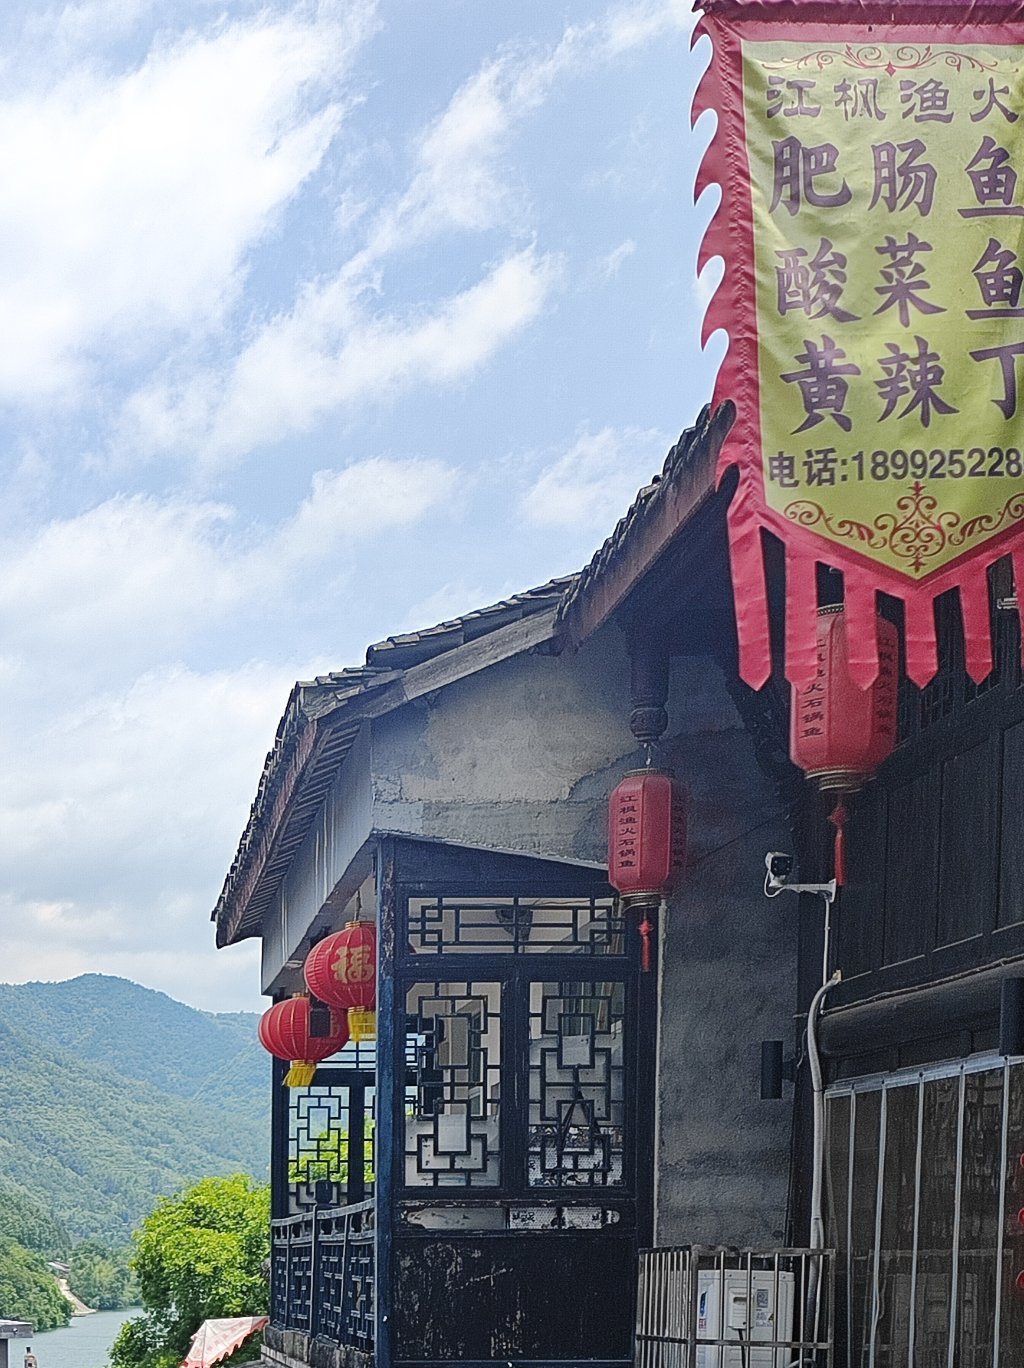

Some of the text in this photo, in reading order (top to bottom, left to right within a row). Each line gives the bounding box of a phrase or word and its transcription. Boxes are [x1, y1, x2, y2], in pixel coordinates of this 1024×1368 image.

[768, 135, 1024, 218] 肥肠鱼
[774, 231, 1024, 328] 酸菜鱼
[779, 334, 1024, 436] 黄辣丁
[330, 944, 375, 984] 福
